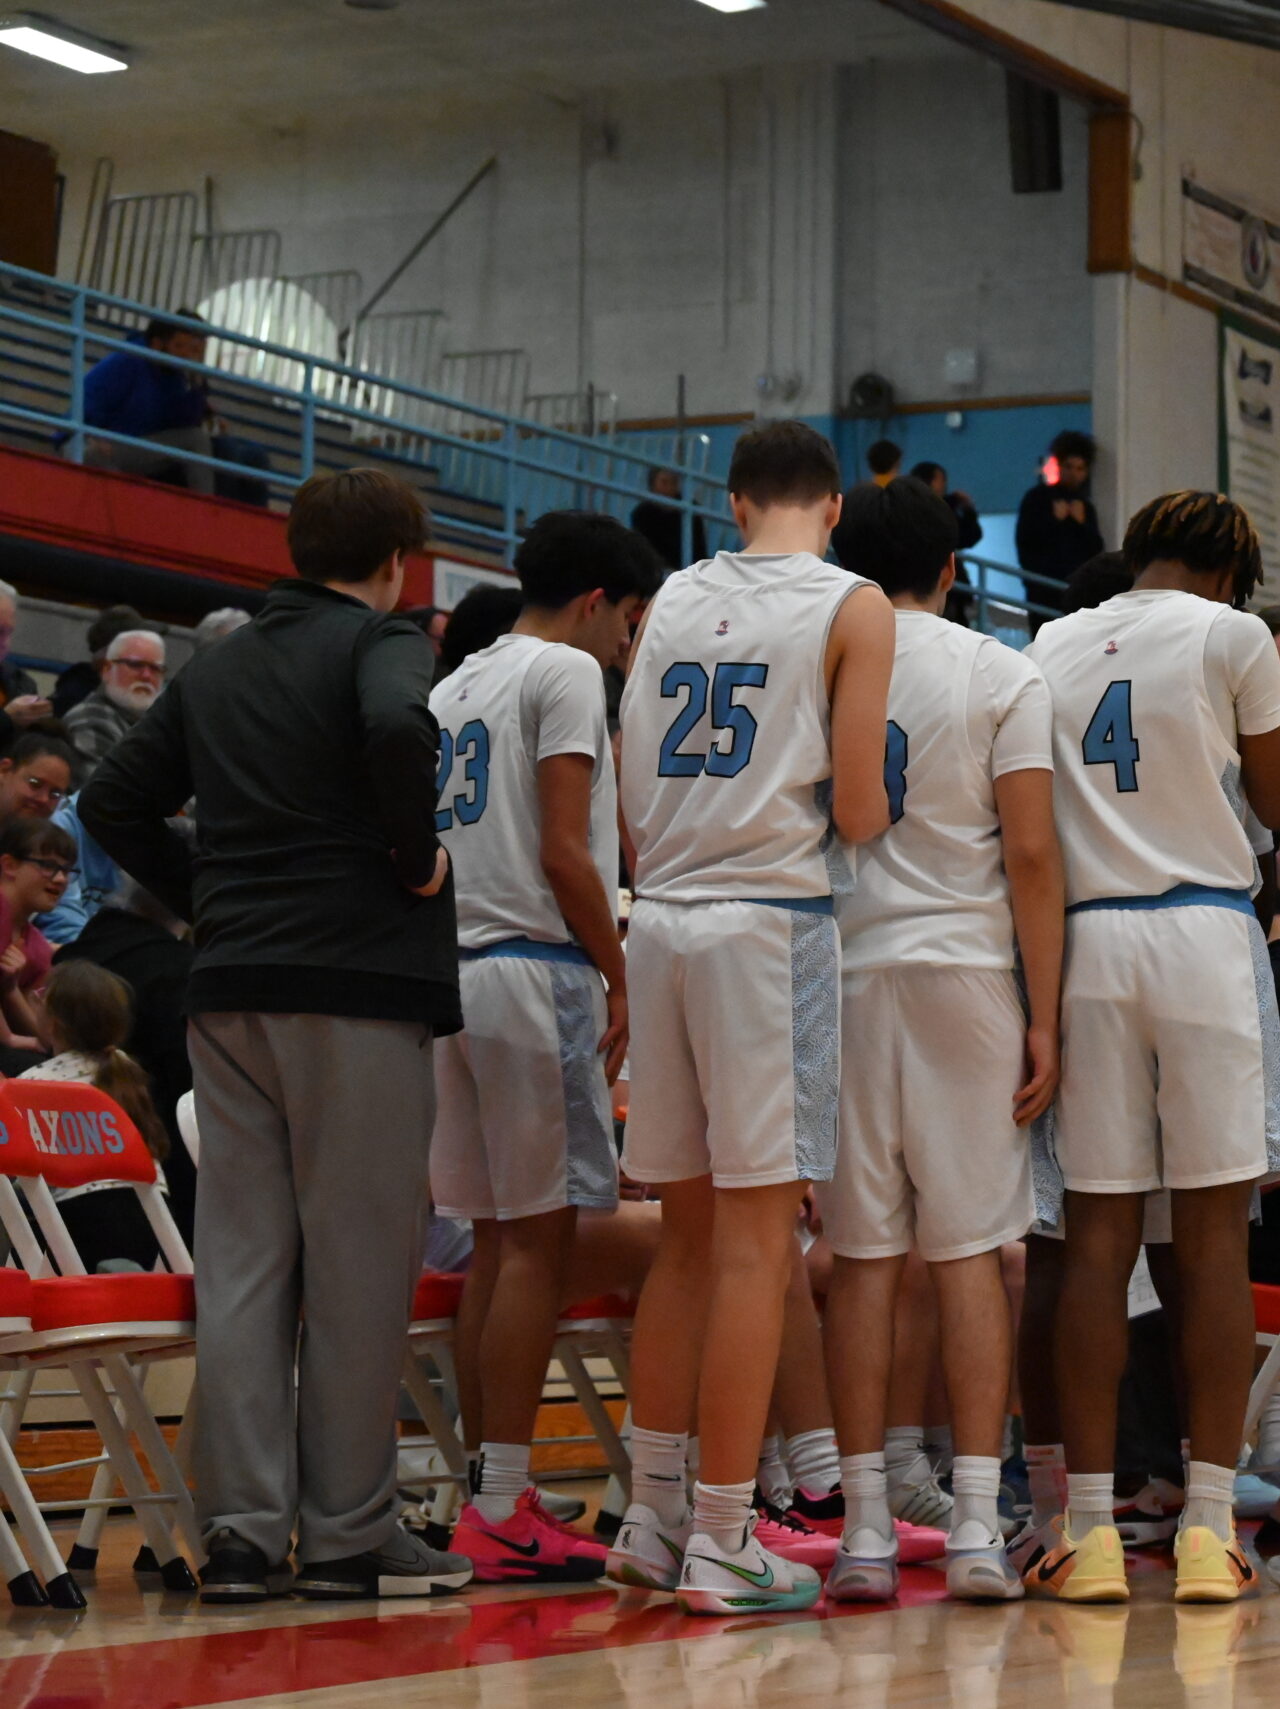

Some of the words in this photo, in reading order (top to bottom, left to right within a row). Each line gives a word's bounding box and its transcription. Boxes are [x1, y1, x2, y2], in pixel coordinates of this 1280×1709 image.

[658, 662, 769, 778] 25
[1082, 680, 1141, 793] 4
[15, 1106, 125, 1155] AXONS
